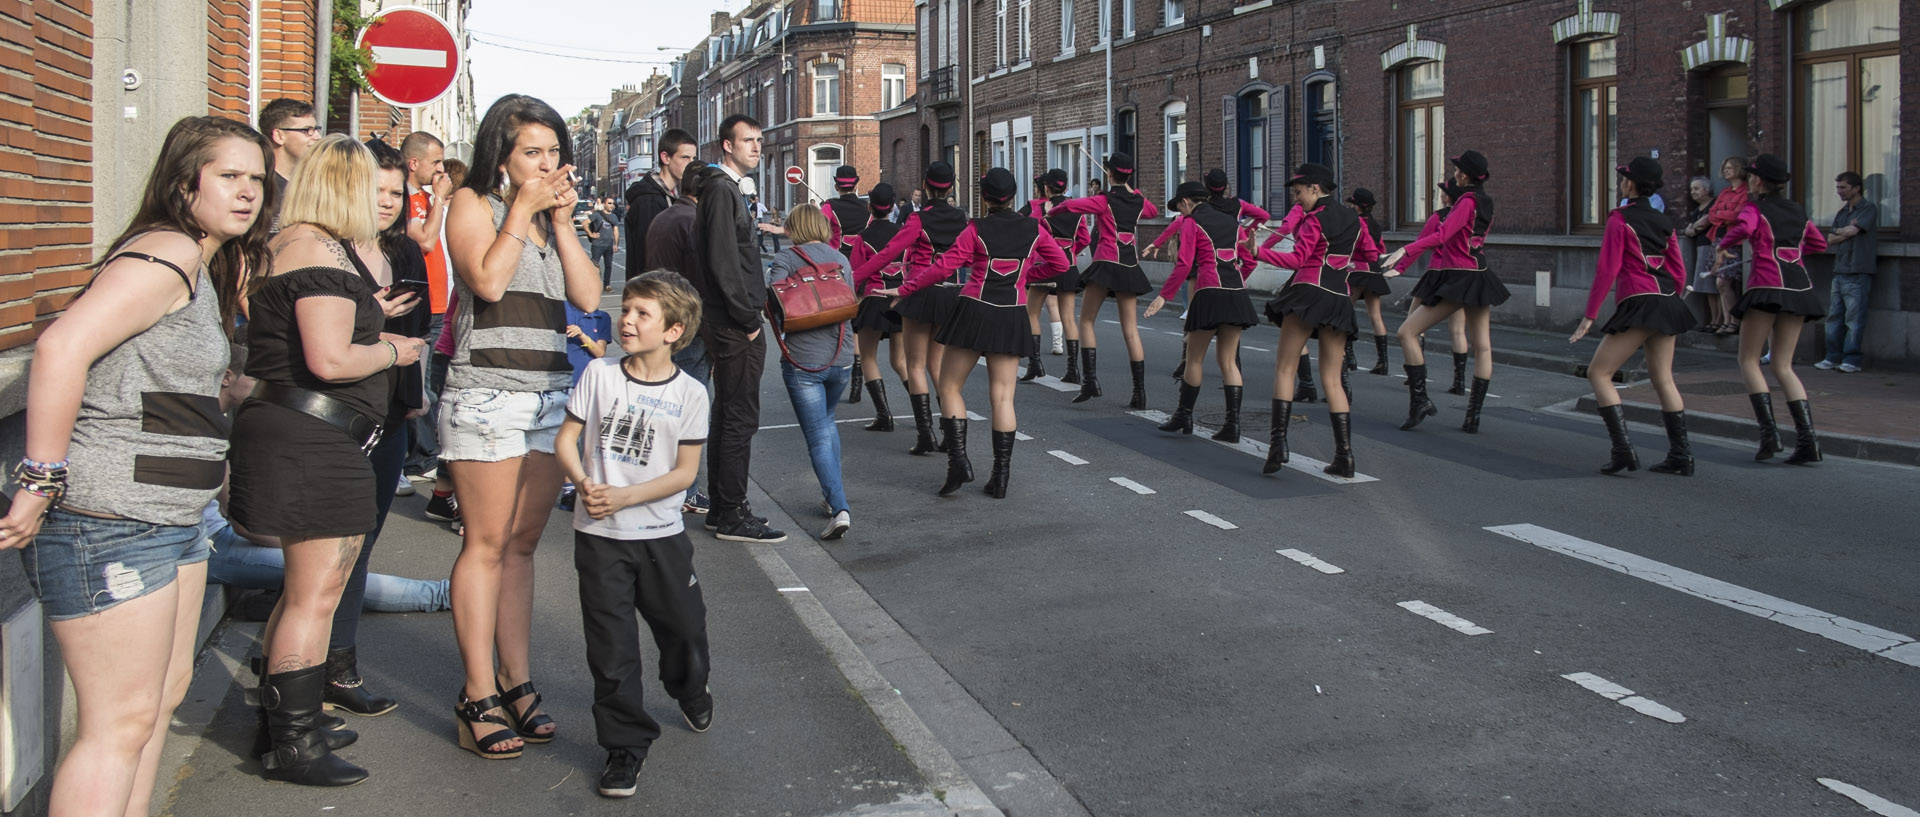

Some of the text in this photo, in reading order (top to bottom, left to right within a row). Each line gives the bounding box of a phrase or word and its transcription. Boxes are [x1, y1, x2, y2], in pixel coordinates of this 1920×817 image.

[637, 394, 684, 412] FRENCH STYLE
[617, 454, 639, 466] PARIS
